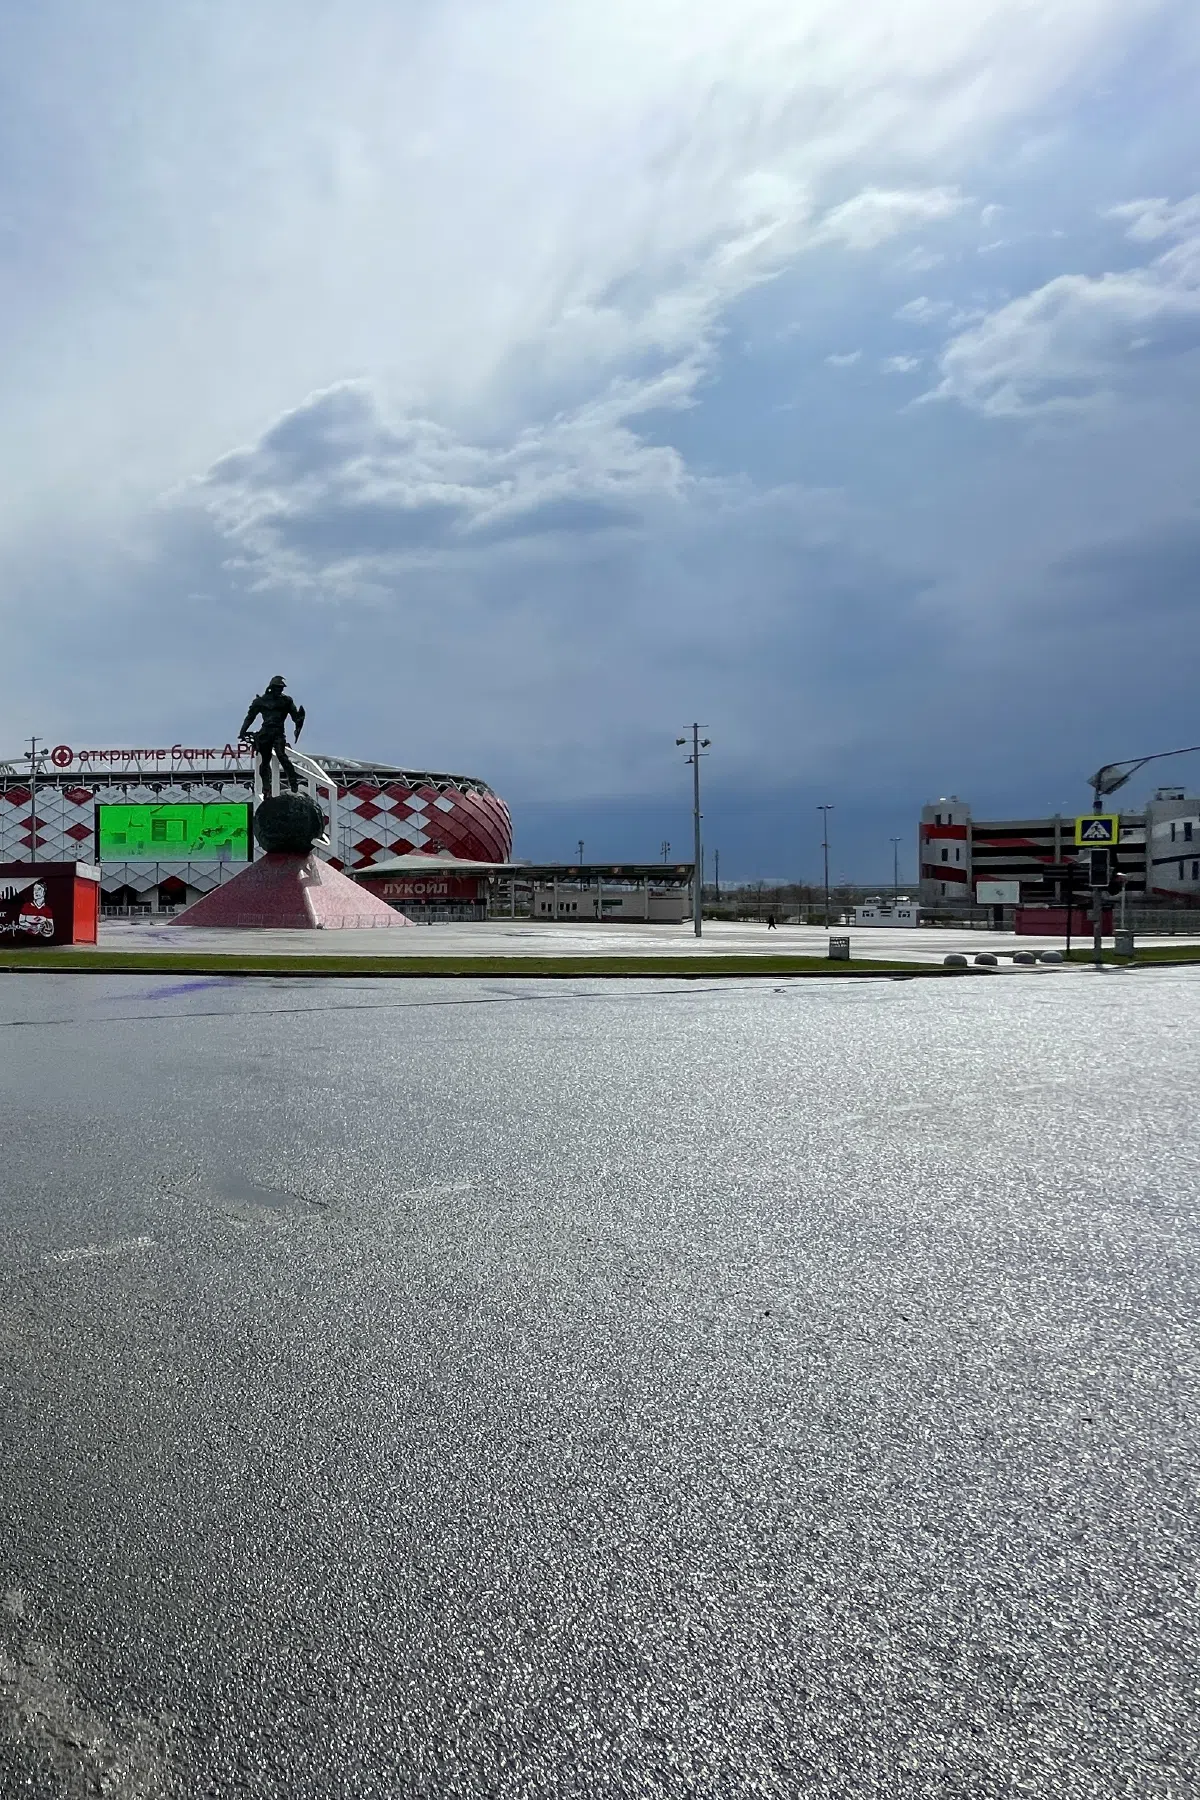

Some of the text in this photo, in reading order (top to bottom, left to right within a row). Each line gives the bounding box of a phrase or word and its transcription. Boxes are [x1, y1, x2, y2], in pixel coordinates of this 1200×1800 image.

[78, 748, 166, 765] открытие
[171, 744, 216, 760] банк
[383, 880, 448, 894] ЛУКОЙЛ
